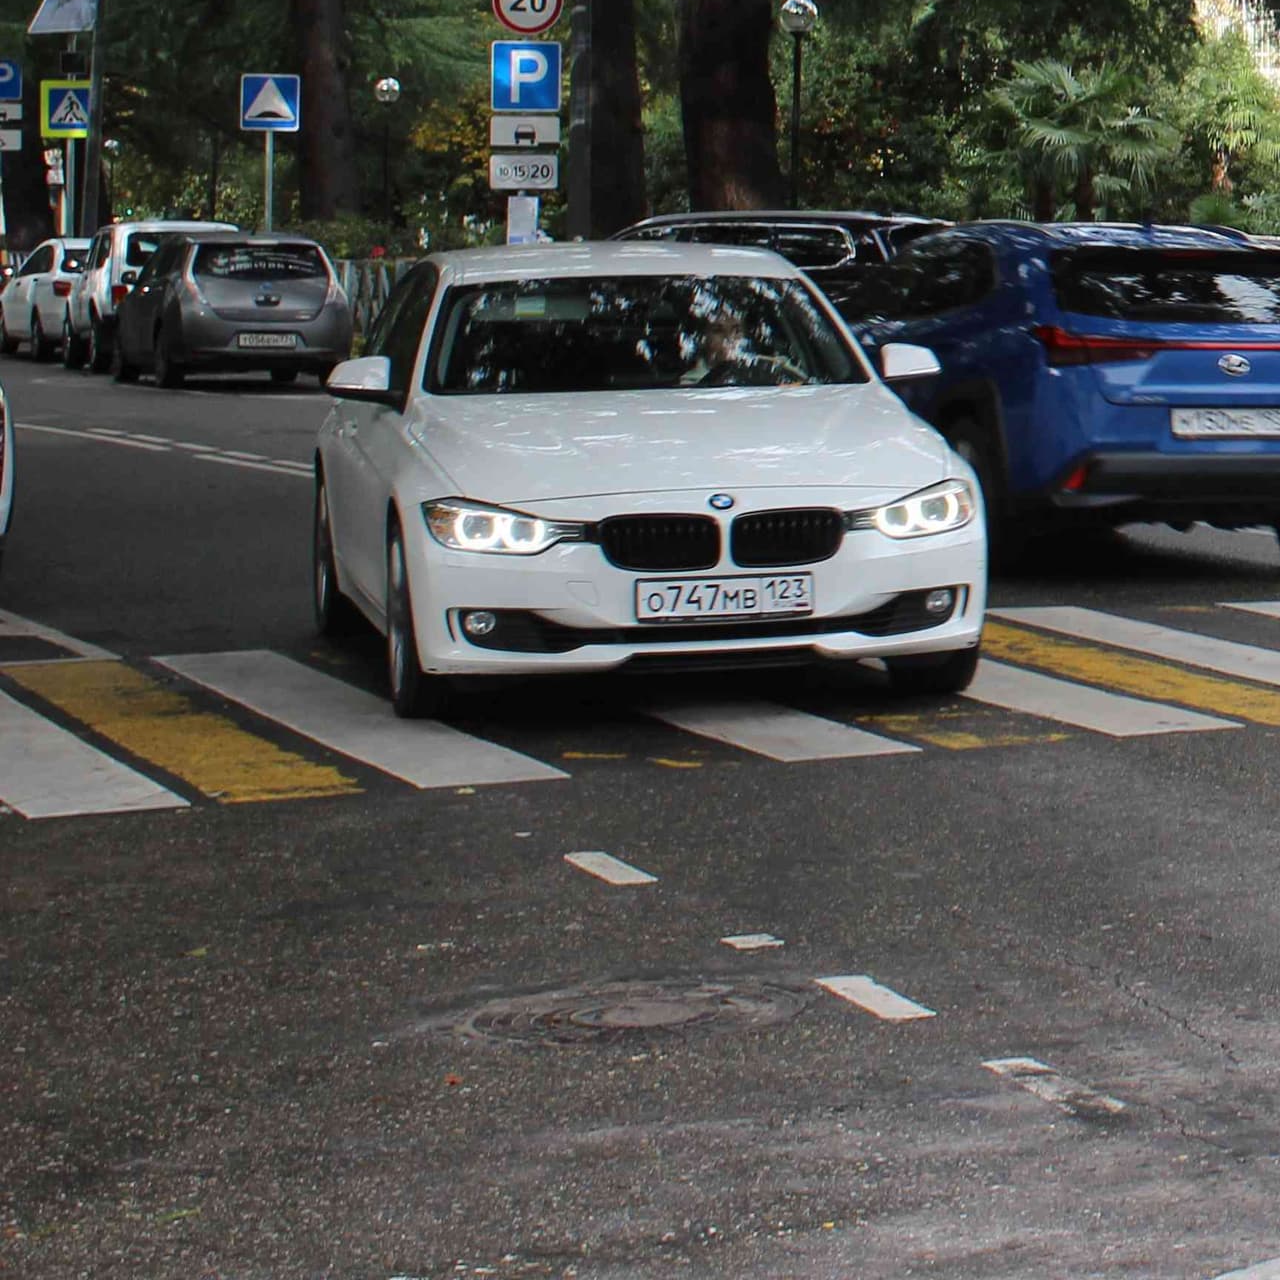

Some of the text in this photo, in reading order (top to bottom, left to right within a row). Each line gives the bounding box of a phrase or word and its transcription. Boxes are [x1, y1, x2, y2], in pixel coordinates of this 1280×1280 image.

[510, 49, 549, 104] P
[499, 164, 550, 179] 10 15 20
[765, 578, 805, 600] 123
